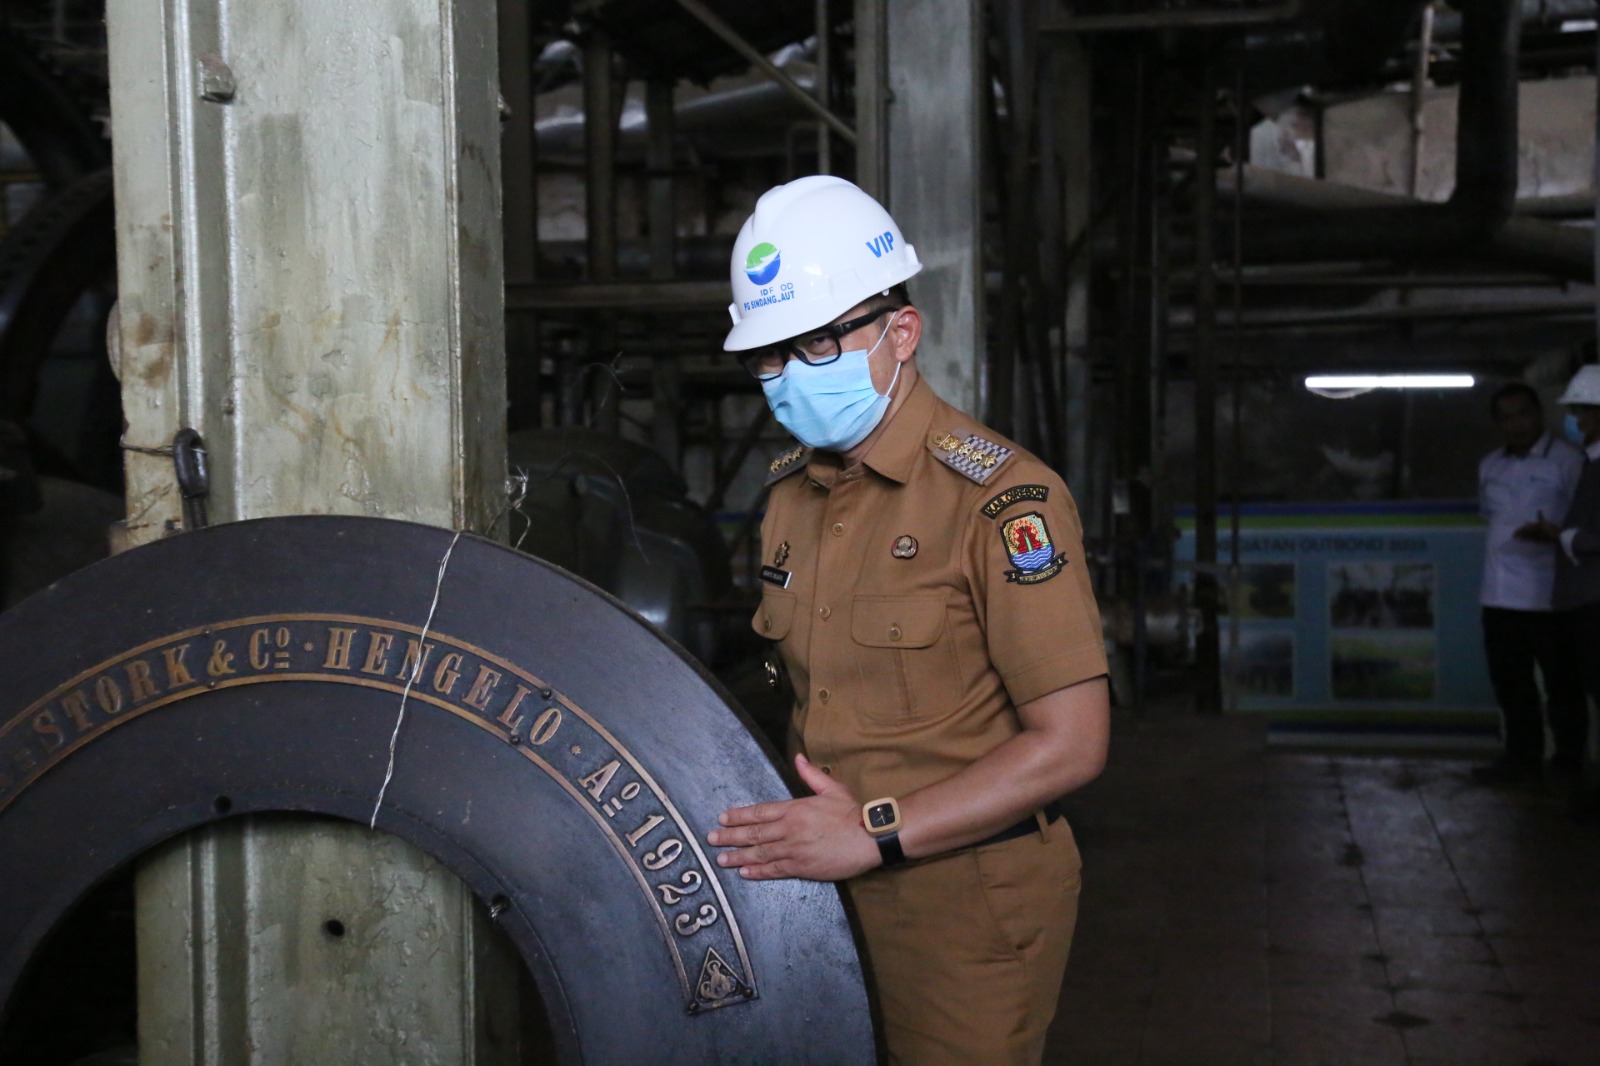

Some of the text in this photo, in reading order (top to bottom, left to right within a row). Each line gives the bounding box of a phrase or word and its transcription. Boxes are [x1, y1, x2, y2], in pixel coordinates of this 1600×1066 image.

[865, 230, 894, 258] VIP
[743, 290, 795, 311] PG SINDANGAUT
[32, 643, 197, 750] STORK
[206, 638, 237, 677] &
[322, 627, 562, 746] HENGELO
[625, 814, 718, 936] 1923
